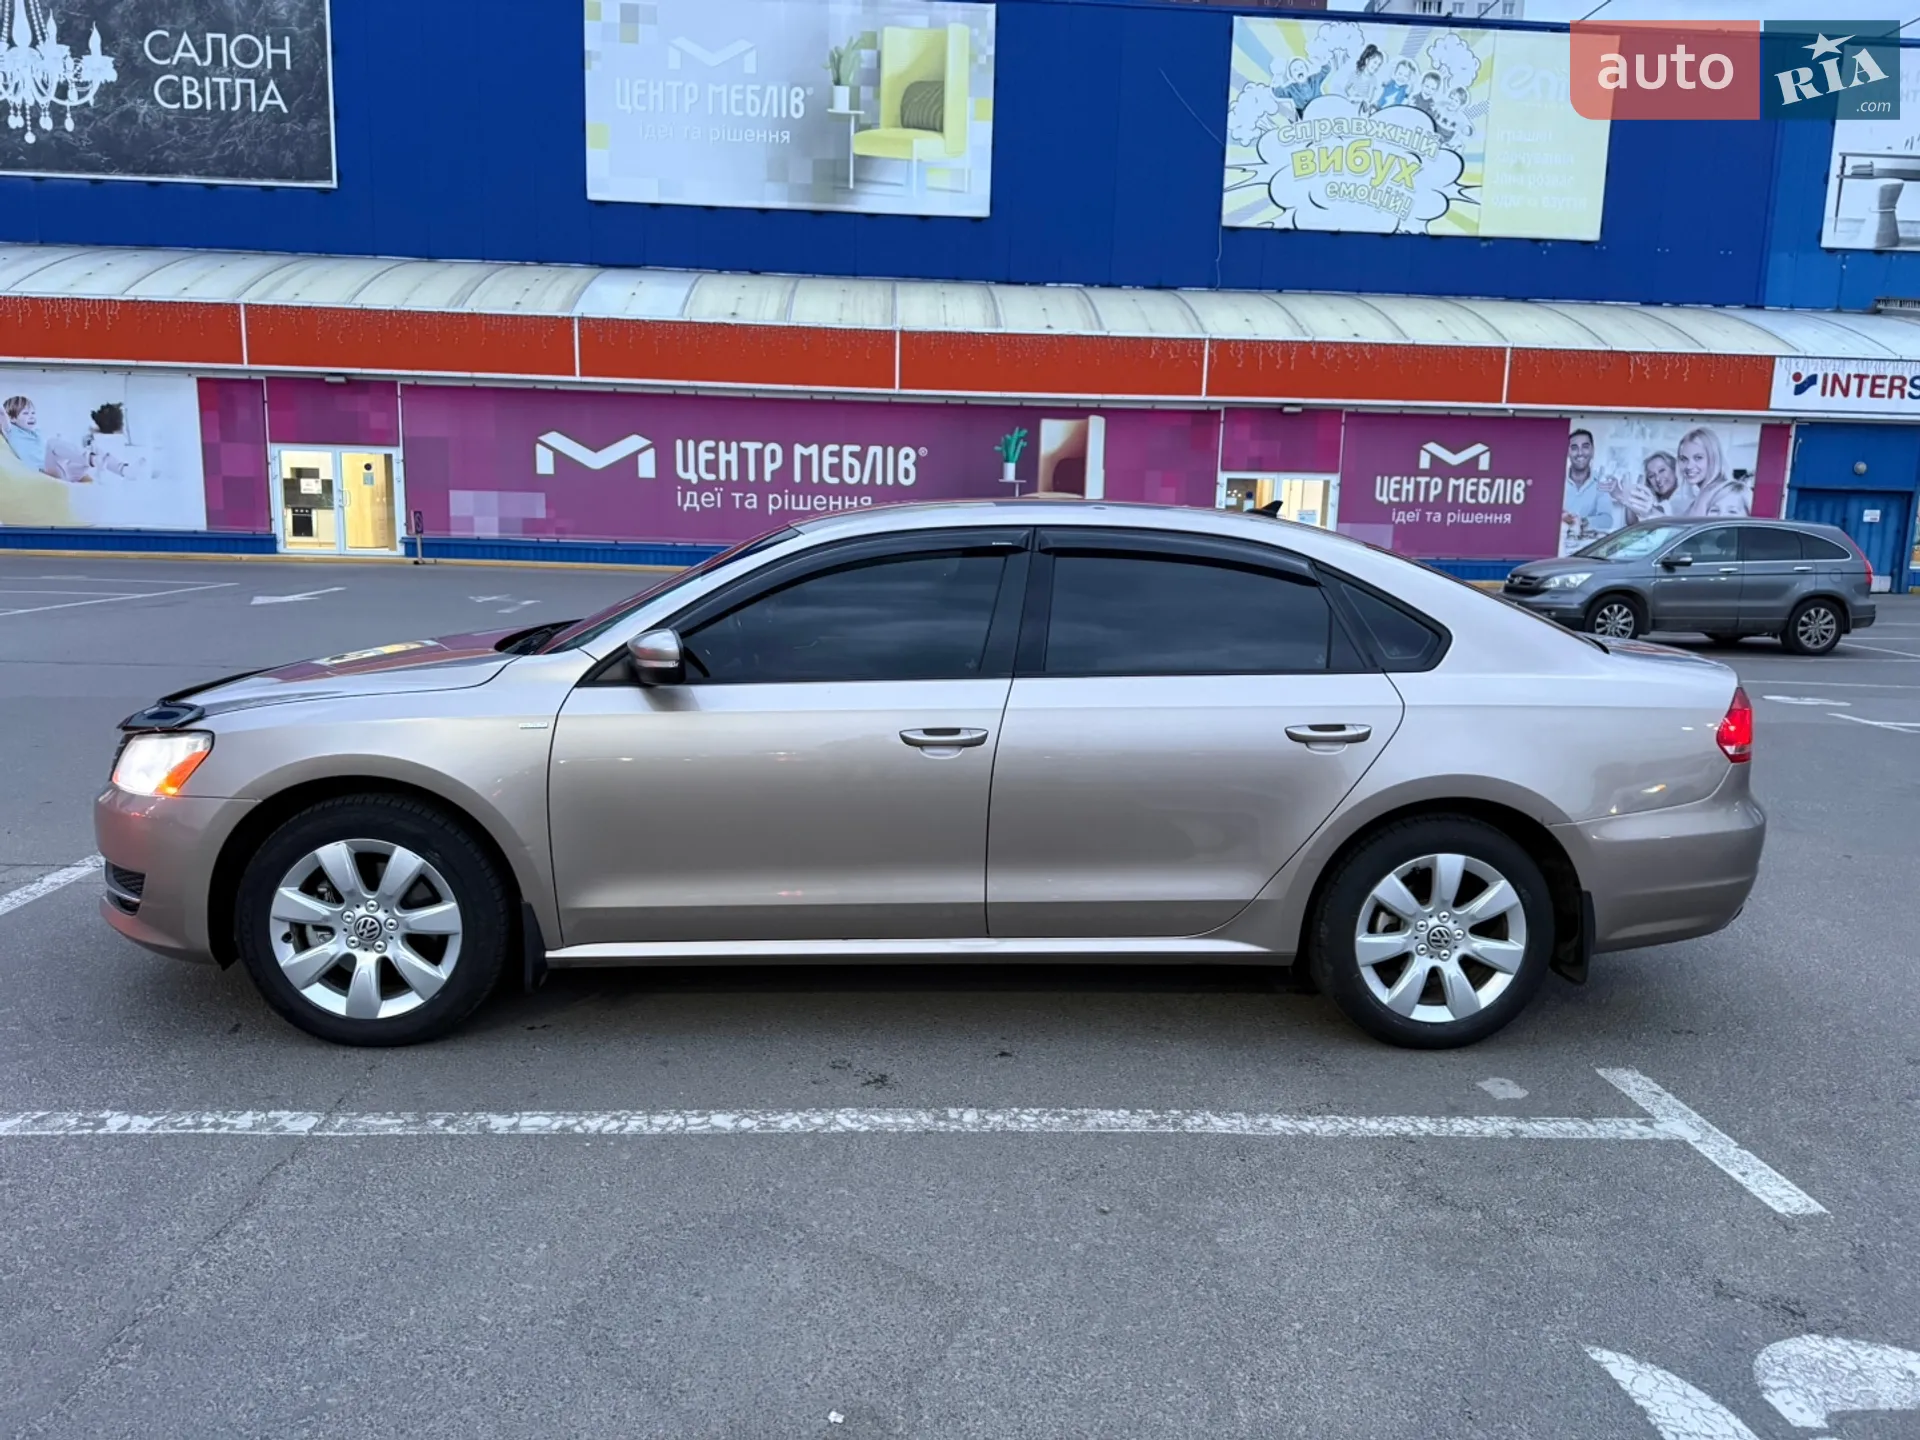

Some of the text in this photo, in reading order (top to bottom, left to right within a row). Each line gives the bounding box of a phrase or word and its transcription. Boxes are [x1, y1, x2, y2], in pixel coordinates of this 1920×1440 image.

[143, 30, 292, 70] САЛОН
[153, 75, 289, 114] СВІТЛА
[616, 78, 699, 114] ЦЕНТР
[709, 124, 791, 145] рішення
[1278, 116, 1442, 159] справжній
[1291, 138, 1422, 190] вибух
[1325, 181, 1415, 219] емоцій!
[676, 438, 783, 484] ЦЕНТР
[677, 486, 724, 512] ідеї
[731, 492, 758, 509] та
[1375, 475, 1443, 505] ЦЕНТР
[1391, 508, 1512, 526] ідеї та рішення
